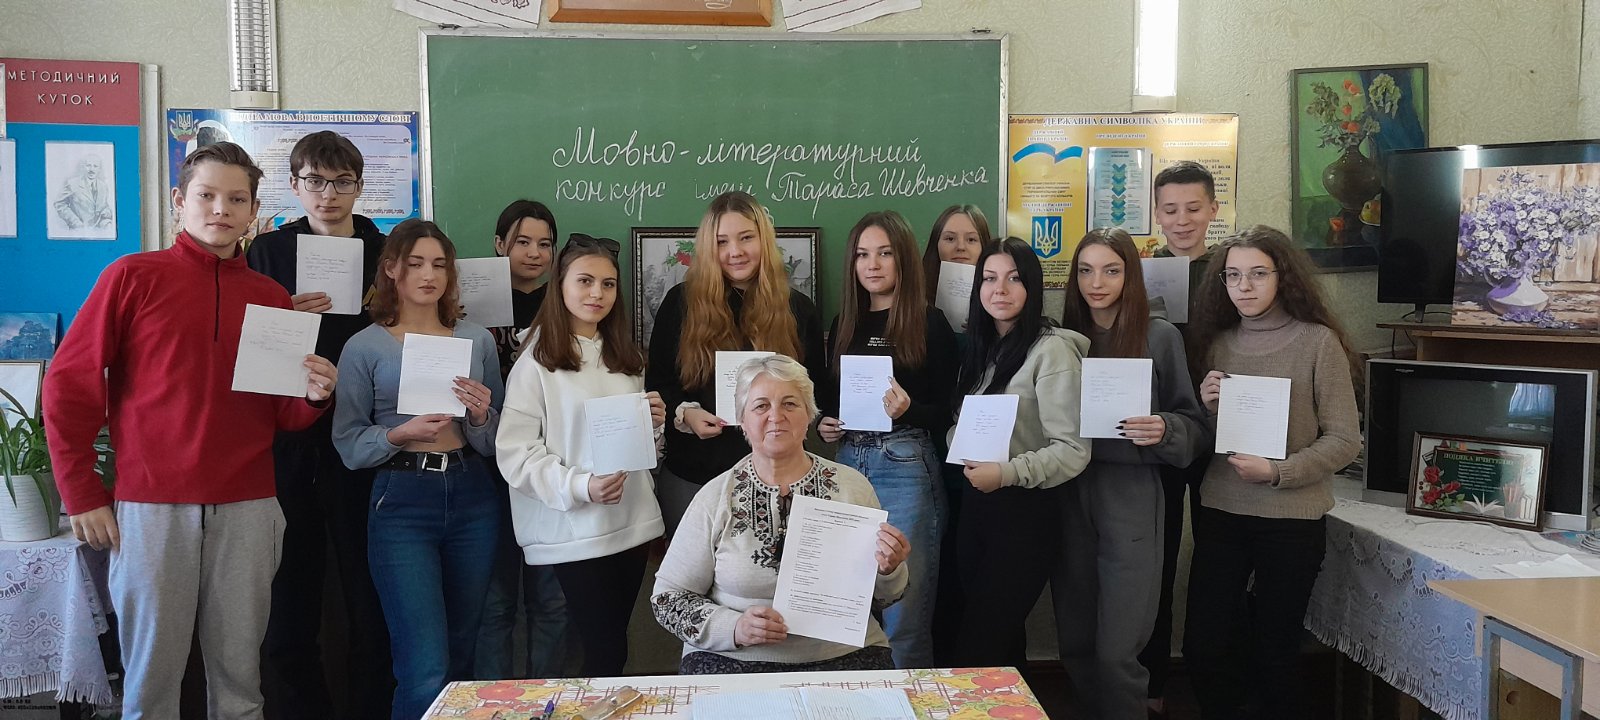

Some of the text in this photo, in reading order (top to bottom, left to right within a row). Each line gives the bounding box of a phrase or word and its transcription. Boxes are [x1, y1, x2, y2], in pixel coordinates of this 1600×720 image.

[8, 70, 120, 84] МЕТОДИЧНИЙ
[37, 93, 94, 105] КУТОК
[263, 112, 297, 122] МОВА
[304, 113, 378, 123] ПОЕТИЧНОМУ
[379, 114, 412, 124] СЛОВІ
[1044, 115, 1204, 127] ДЕРЖАВНА СИМВОЛІКА УКРАЇНИ
[555, 178, 667, 222] конкурс
[771, 171, 875, 220] Тараса
[878, 163, 990, 198] Шевченка
